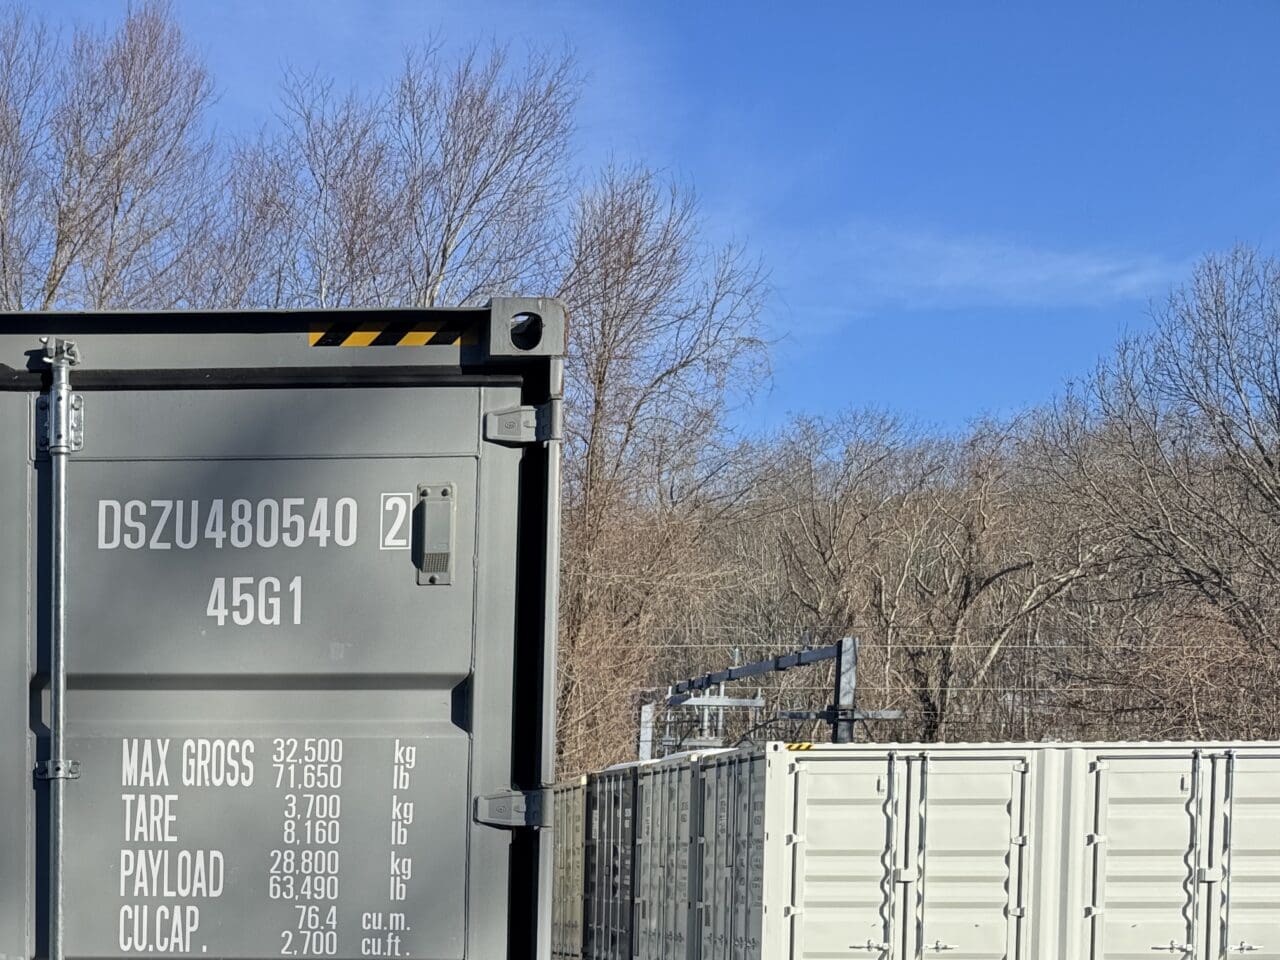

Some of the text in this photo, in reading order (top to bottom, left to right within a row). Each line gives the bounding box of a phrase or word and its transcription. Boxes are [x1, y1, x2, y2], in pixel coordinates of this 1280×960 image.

[384, 496, 407, 547] 2
[206, 576, 302, 626] 45G1
[122, 738, 416, 787] MAX GROSS 32,500 kg
[272, 764, 410, 790] 71,650 lb
[121, 794, 414, 842] TARE 3,700 kg
[283, 820, 408, 845] 8,160 lb
[120, 849, 412, 897] PAYLOAD 28,800 kg
[269, 876, 407, 901] 63,490 lb
[294, 905, 337, 930] 76.4
[361, 911, 411, 931] cu.m.
[280, 930, 337, 956] 2,700
